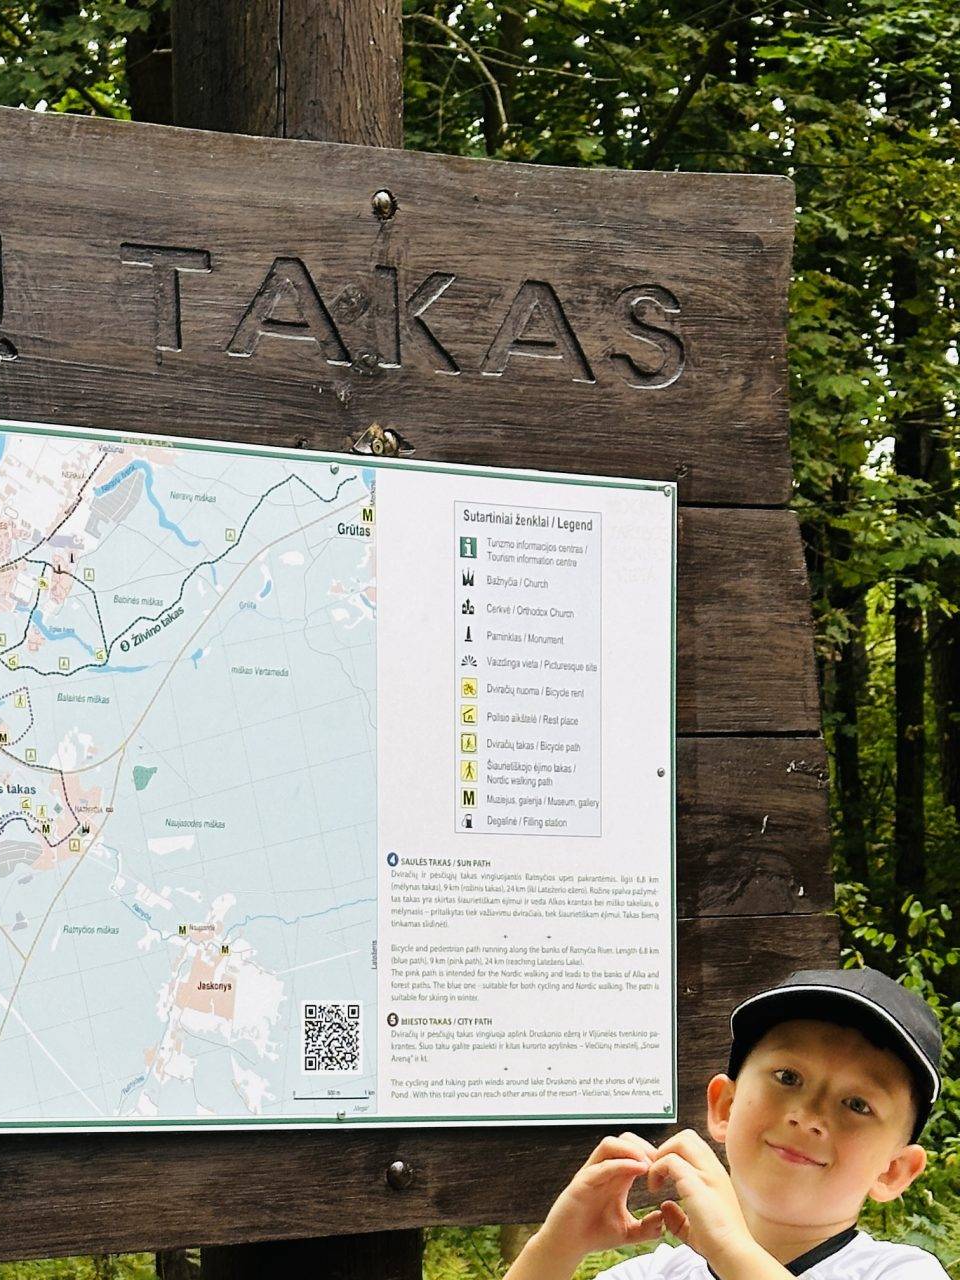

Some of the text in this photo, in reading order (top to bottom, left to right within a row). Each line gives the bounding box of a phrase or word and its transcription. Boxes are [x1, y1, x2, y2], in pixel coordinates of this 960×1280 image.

[121, 242, 687, 390] TAKAS
[363, 508, 372, 521] M
[463, 508, 513, 524] Sutartiniai
[515, 513, 549, 527] ženklai
[557, 516, 592, 532] Legend
[338, 522, 371, 537] Grūtas
[132, 624, 161, 646] Žilvino
[161, 606, 184, 627] takas
[6, 784, 36, 794] takas
[463, 790, 475, 805] M
[401, 856, 426, 866] SAULĖS
[428, 858, 451, 866] TAKAS
[456, 859, 472, 867] SUN
[472, 859, 491, 867] PATH
[197, 981, 232, 991] Jaskonys
[428, 1018, 452, 1026] TAKAS
[456, 1017, 473, 1025] CITY
[474, 1017, 492, 1025] PATH
